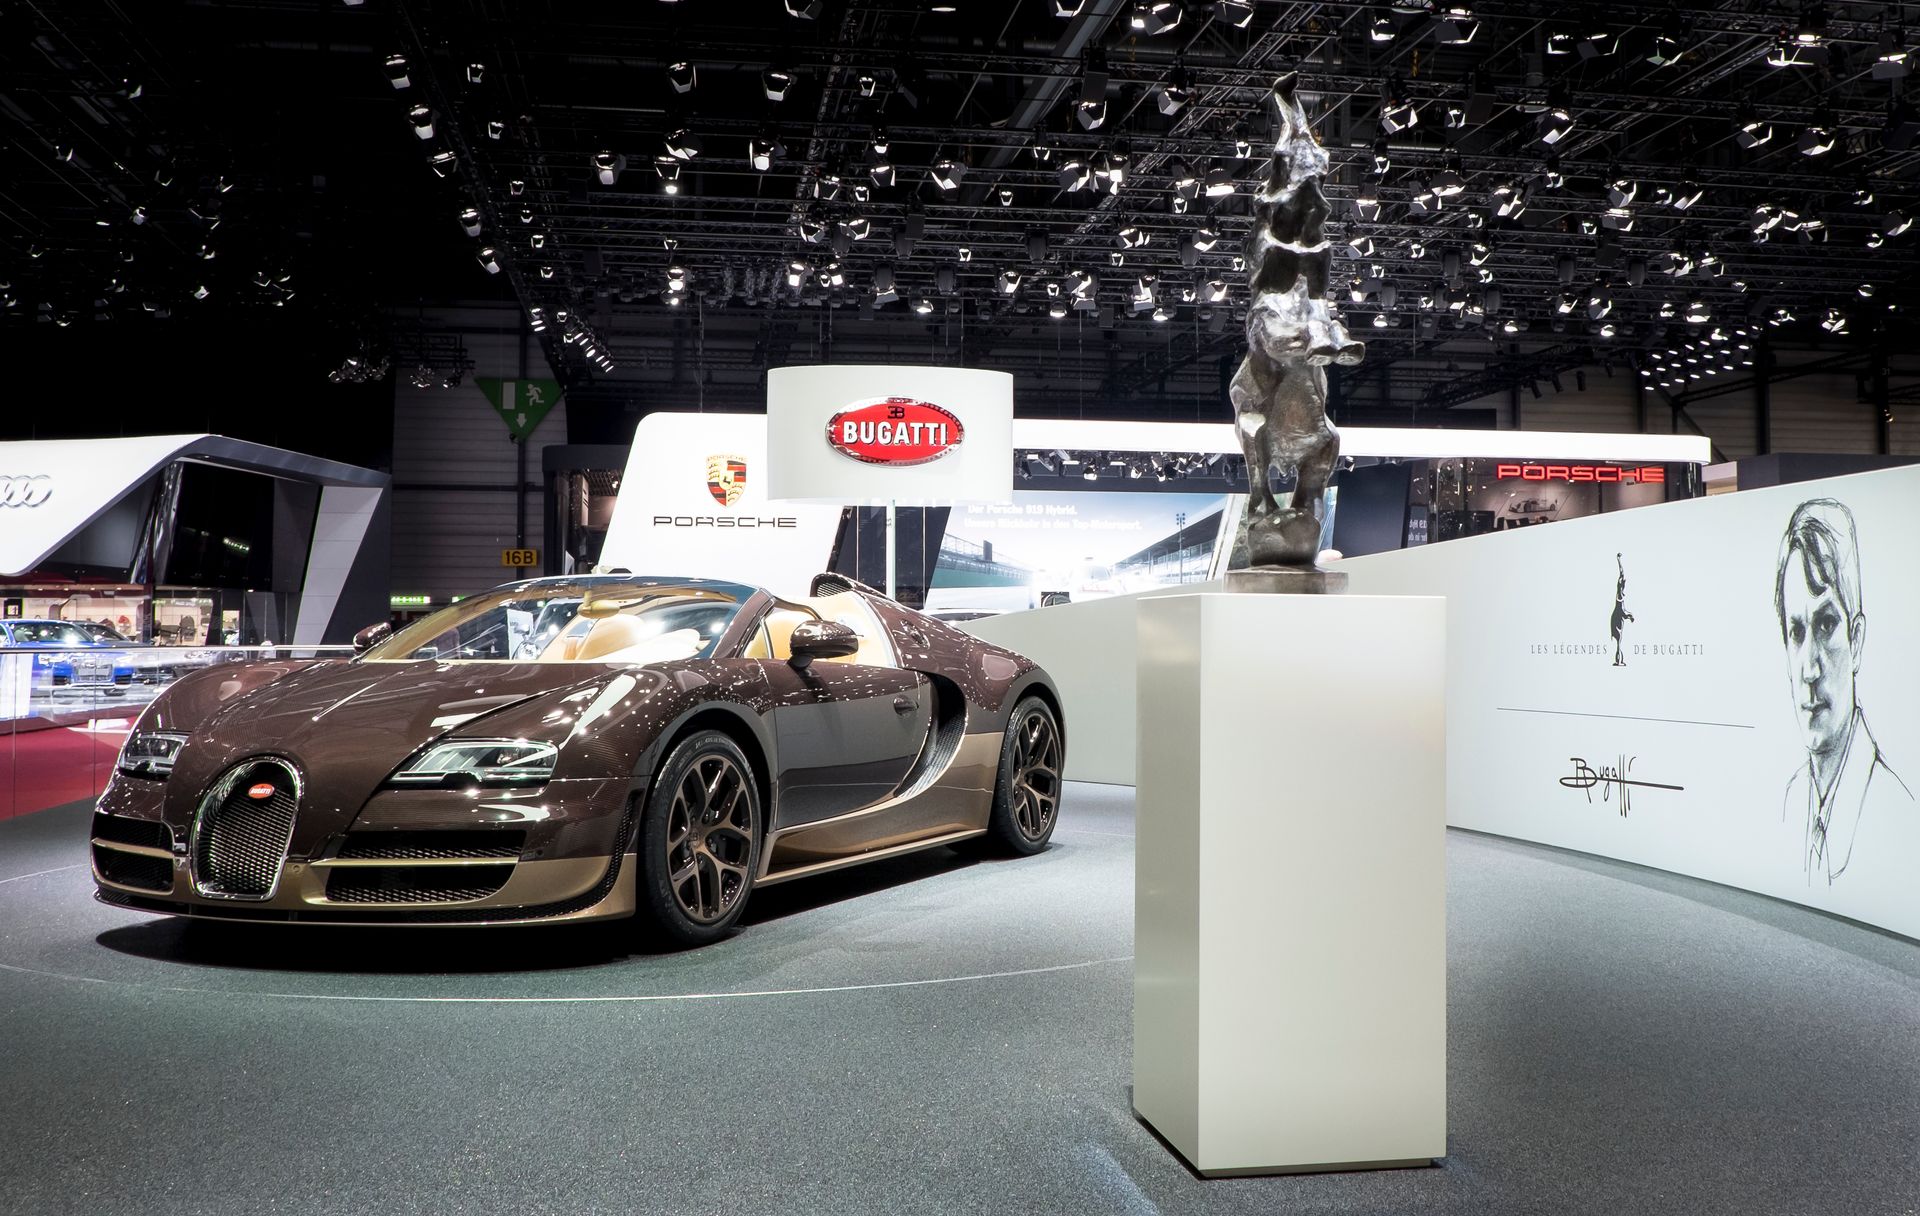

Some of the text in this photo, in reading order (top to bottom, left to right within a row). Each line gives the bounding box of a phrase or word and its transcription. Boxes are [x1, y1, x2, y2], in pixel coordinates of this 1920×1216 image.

[843, 421, 948, 446] BUGATTI
[1497, 464, 1665, 483] PORSCHE
[1025, 504, 1044, 514] 919
[653, 516, 797, 528] PORSCHE
[505, 550, 533, 565] 16B
[1531, 641, 1704, 656] LES LÉGENDES DE BUGATTI
